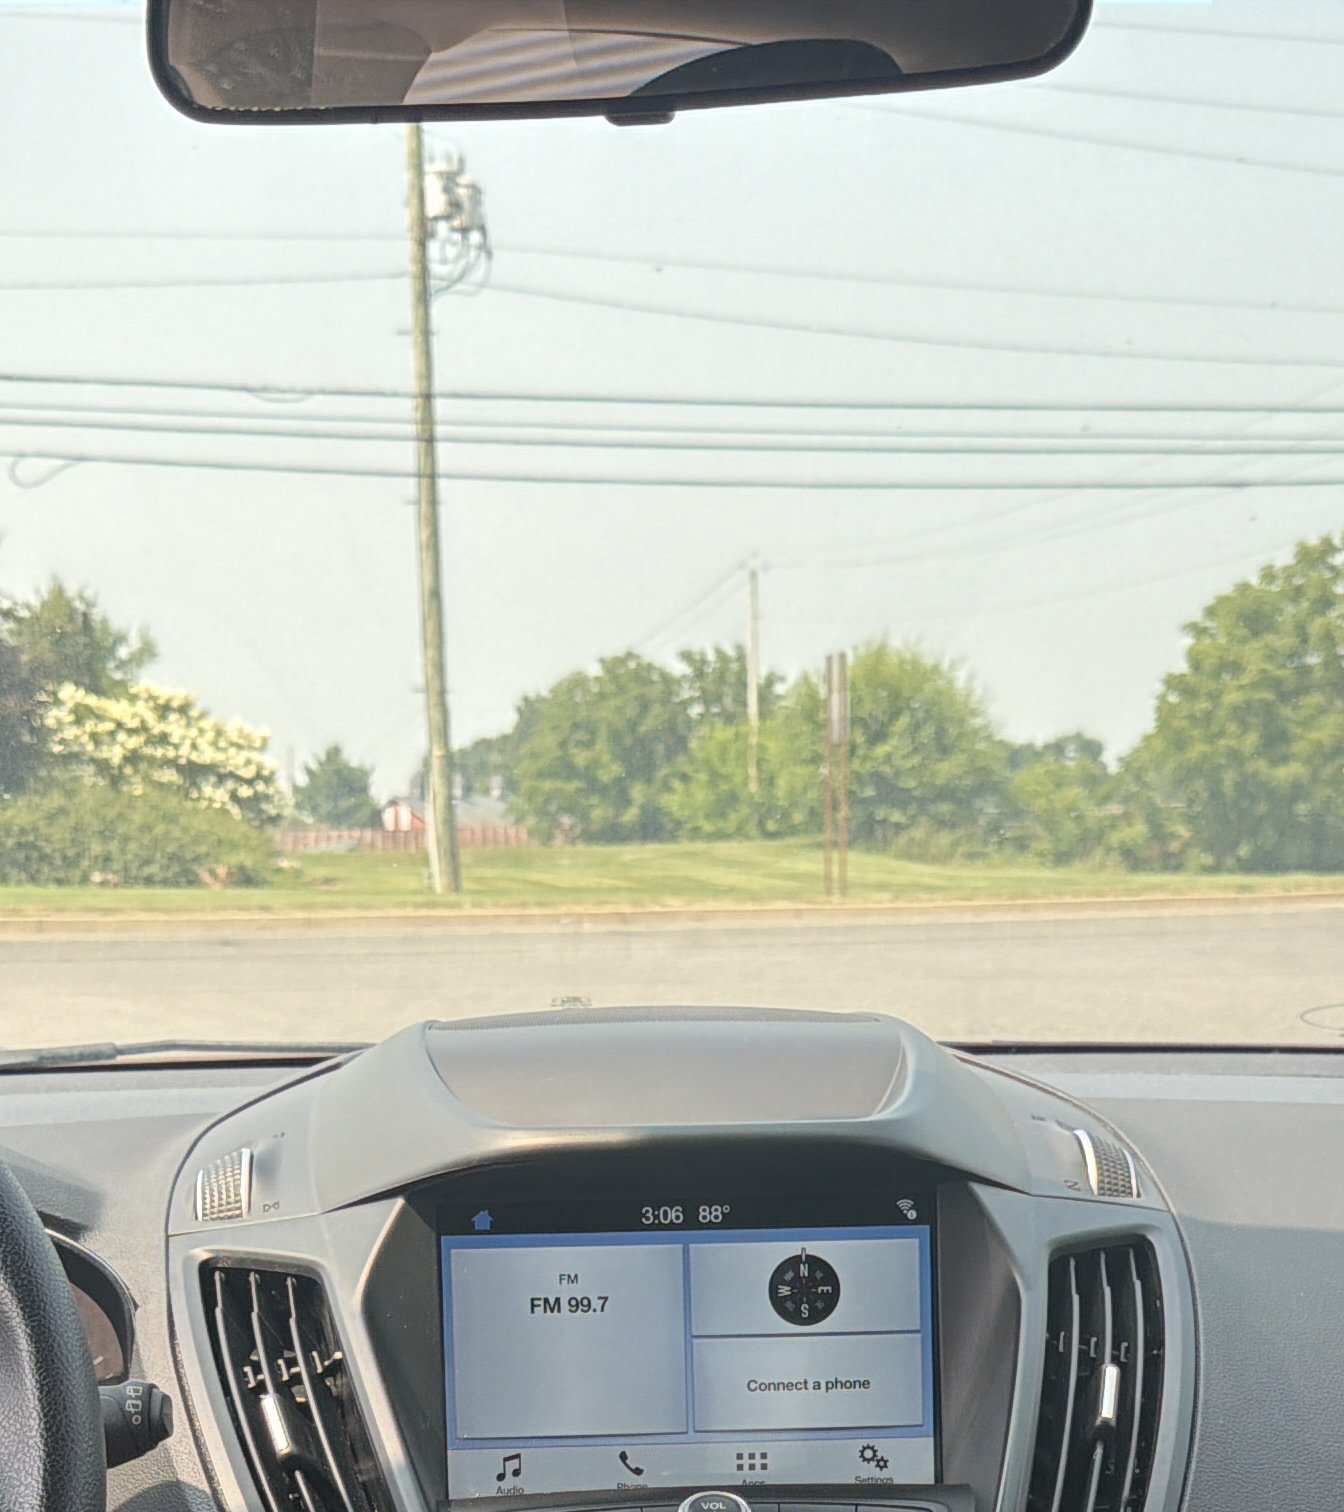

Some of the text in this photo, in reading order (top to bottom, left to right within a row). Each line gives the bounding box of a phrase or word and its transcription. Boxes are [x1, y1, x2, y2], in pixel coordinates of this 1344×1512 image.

[641, 1204, 731, 1224] 3:06 88°
[800, 1263, 809, 1277] N
[558, 1274, 579, 1285] FM
[530, 1296, 609, 1314] FM 99.7
[801, 1304, 810, 1318] S
[747, 1377, 871, 1393] Connect a phone
[496, 1485, 525, 1495] Audio
[701, 1502, 726, 1510] VOL
